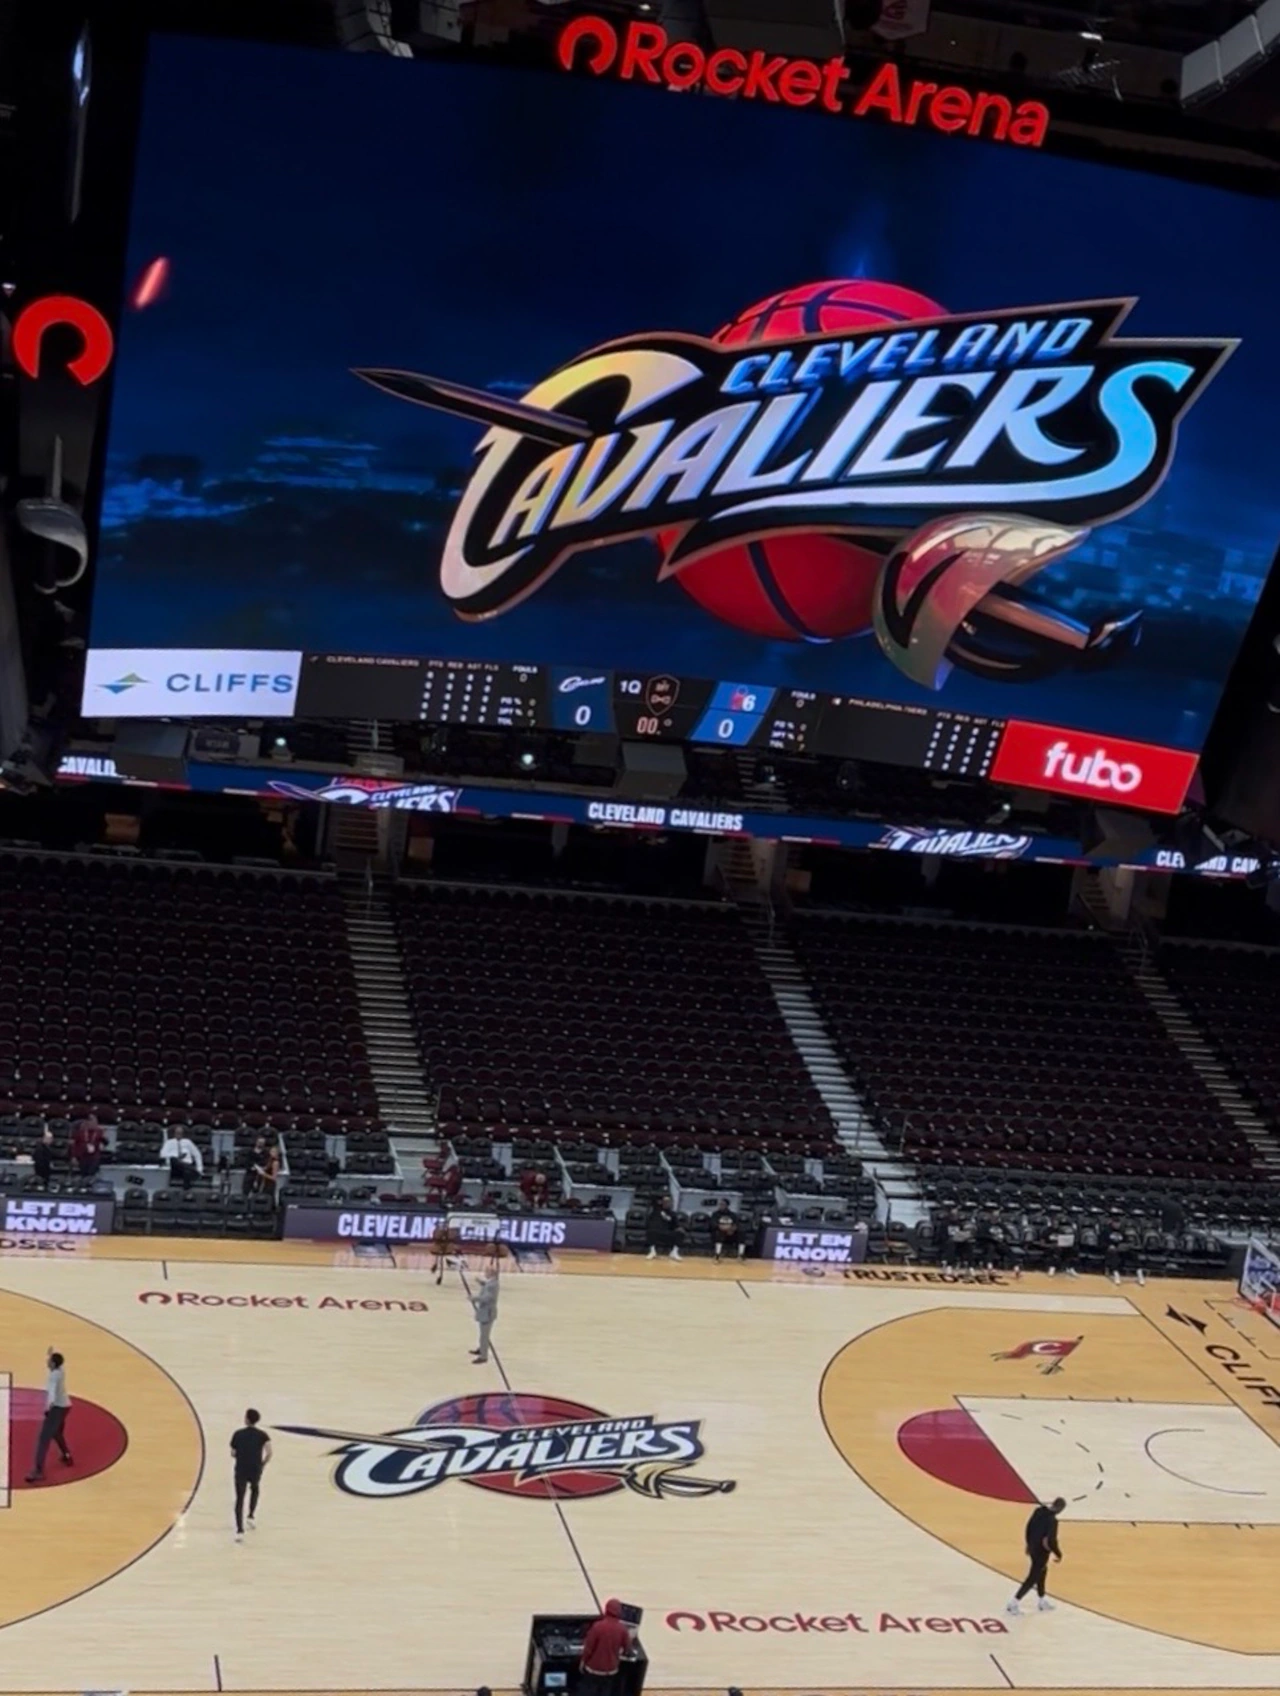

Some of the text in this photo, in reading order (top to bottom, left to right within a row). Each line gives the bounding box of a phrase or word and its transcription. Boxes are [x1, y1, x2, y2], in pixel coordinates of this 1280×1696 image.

[622, 21, 1051, 147] Rocket Arena
[719, 316, 1093, 395] CLEVELAND
[440, 349, 1195, 600] CAVALIERS
[166, 673, 294, 694] CLIFFS
[619, 680, 642, 695] 1Q
[575, 705, 592, 726] 0
[717, 718, 735, 738] 0
[1042, 740, 1142, 793] fubo
[587, 802, 744, 832] CLEVELAND CAVALIERS
[6, 1200, 97, 1217] LET EM
[5, 1215, 98, 1234] KNOW.
[776, 1232, 852, 1248] LET EM
[774, 1246, 852, 1263] KNOW.
[842, 1268, 1010, 1287] TRUSTEDSEC
[176, 1291, 430, 1313] Rocket Arena
[509, 1418, 647, 1442] CLEVELAND
[341, 1424, 698, 1498] CAVALIERS
[707, 1610, 1009, 1635] Rocket Arena
